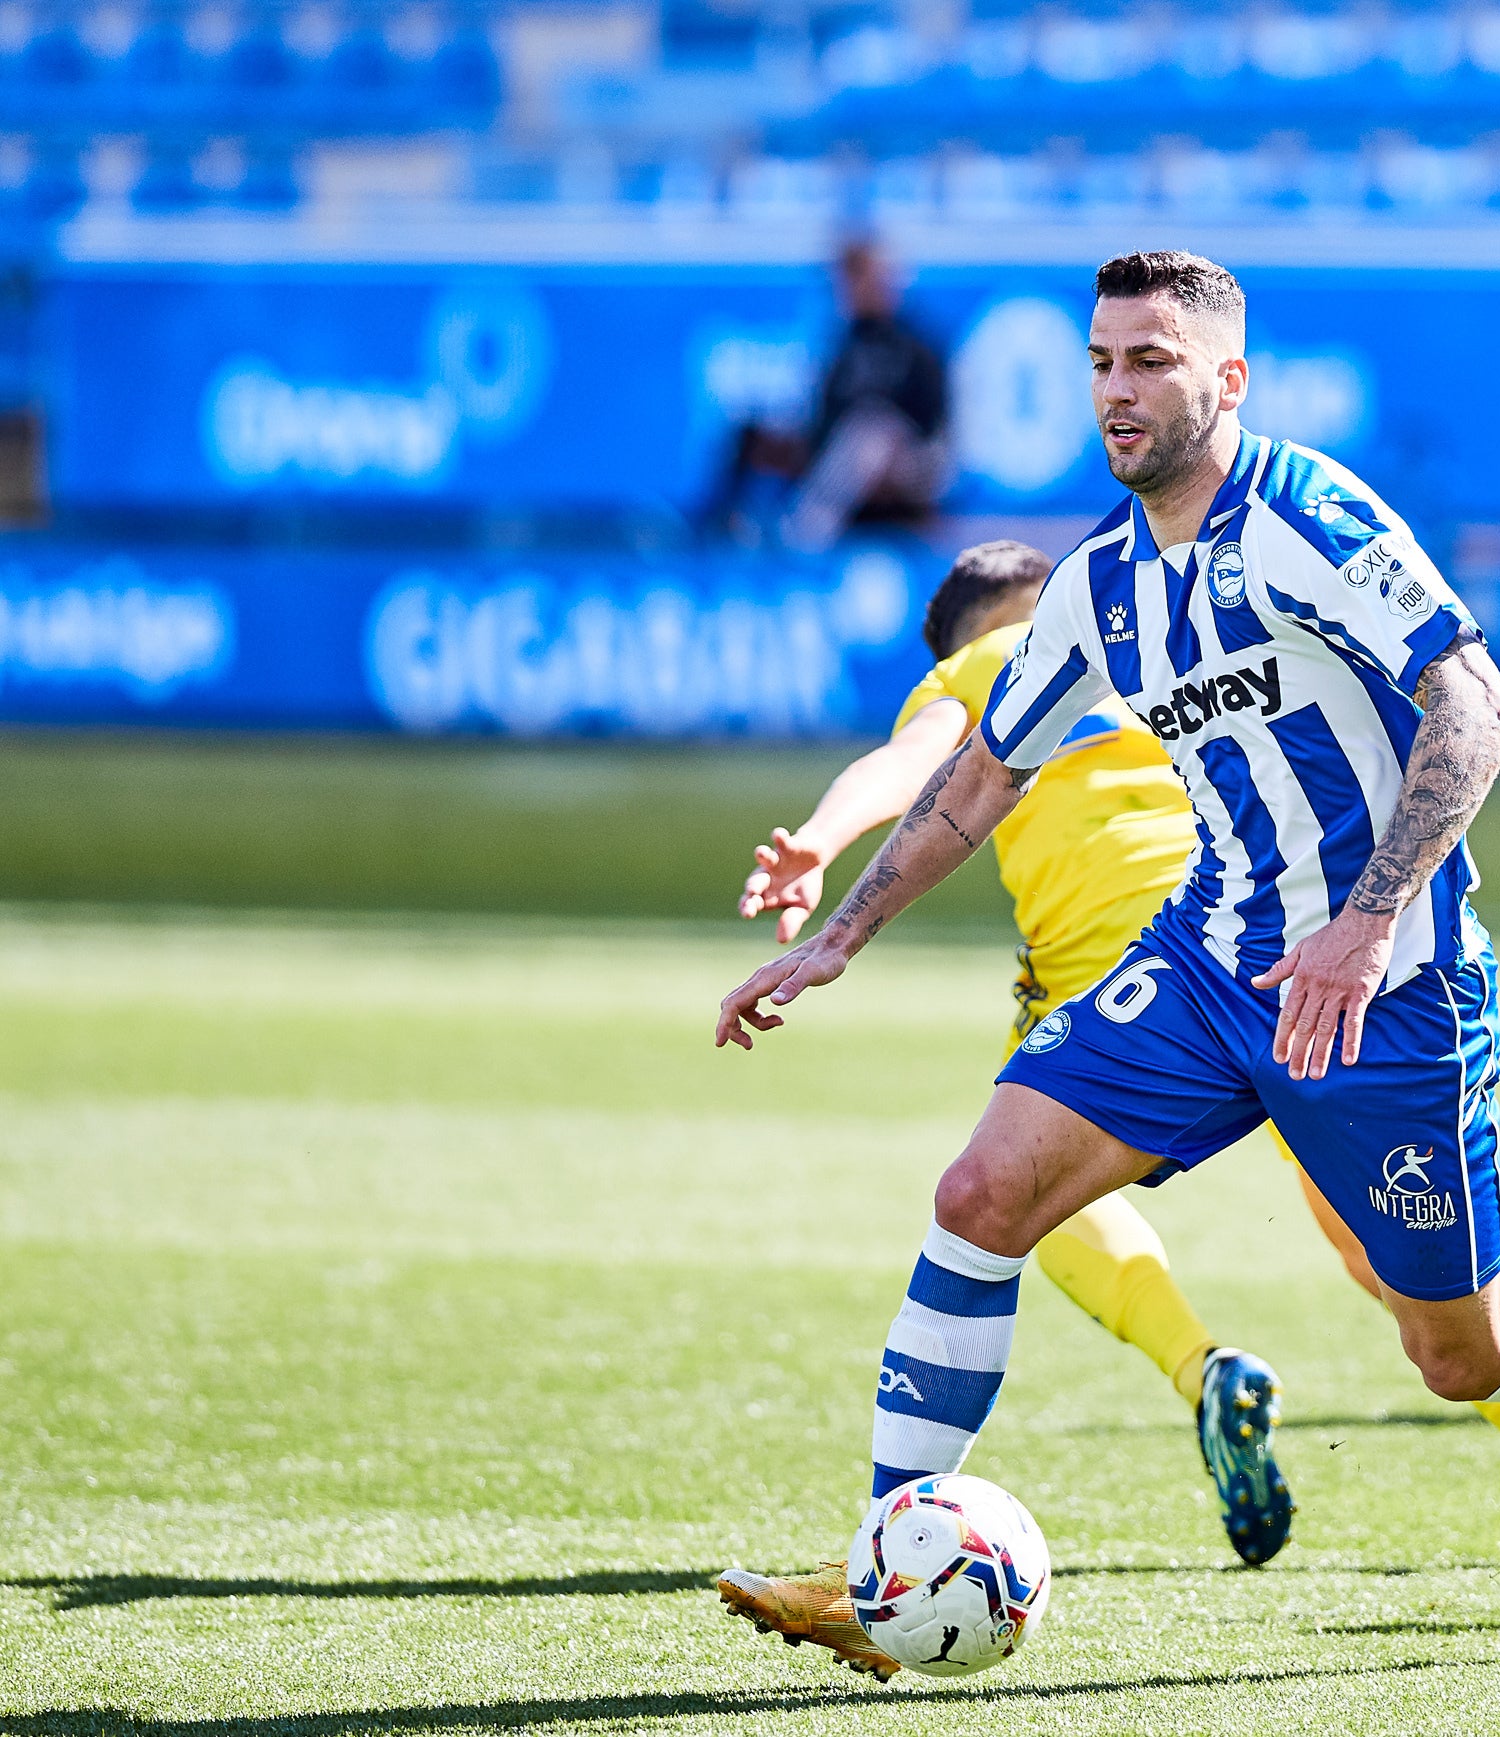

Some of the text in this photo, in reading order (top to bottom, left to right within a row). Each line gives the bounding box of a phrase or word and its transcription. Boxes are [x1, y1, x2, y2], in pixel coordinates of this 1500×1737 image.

[1397, 581, 1426, 613] FOOD
[1104, 630, 1136, 645] KELME
[1126, 656, 1282, 740] etway
[1368, 1185, 1456, 1222] INTEGRA
